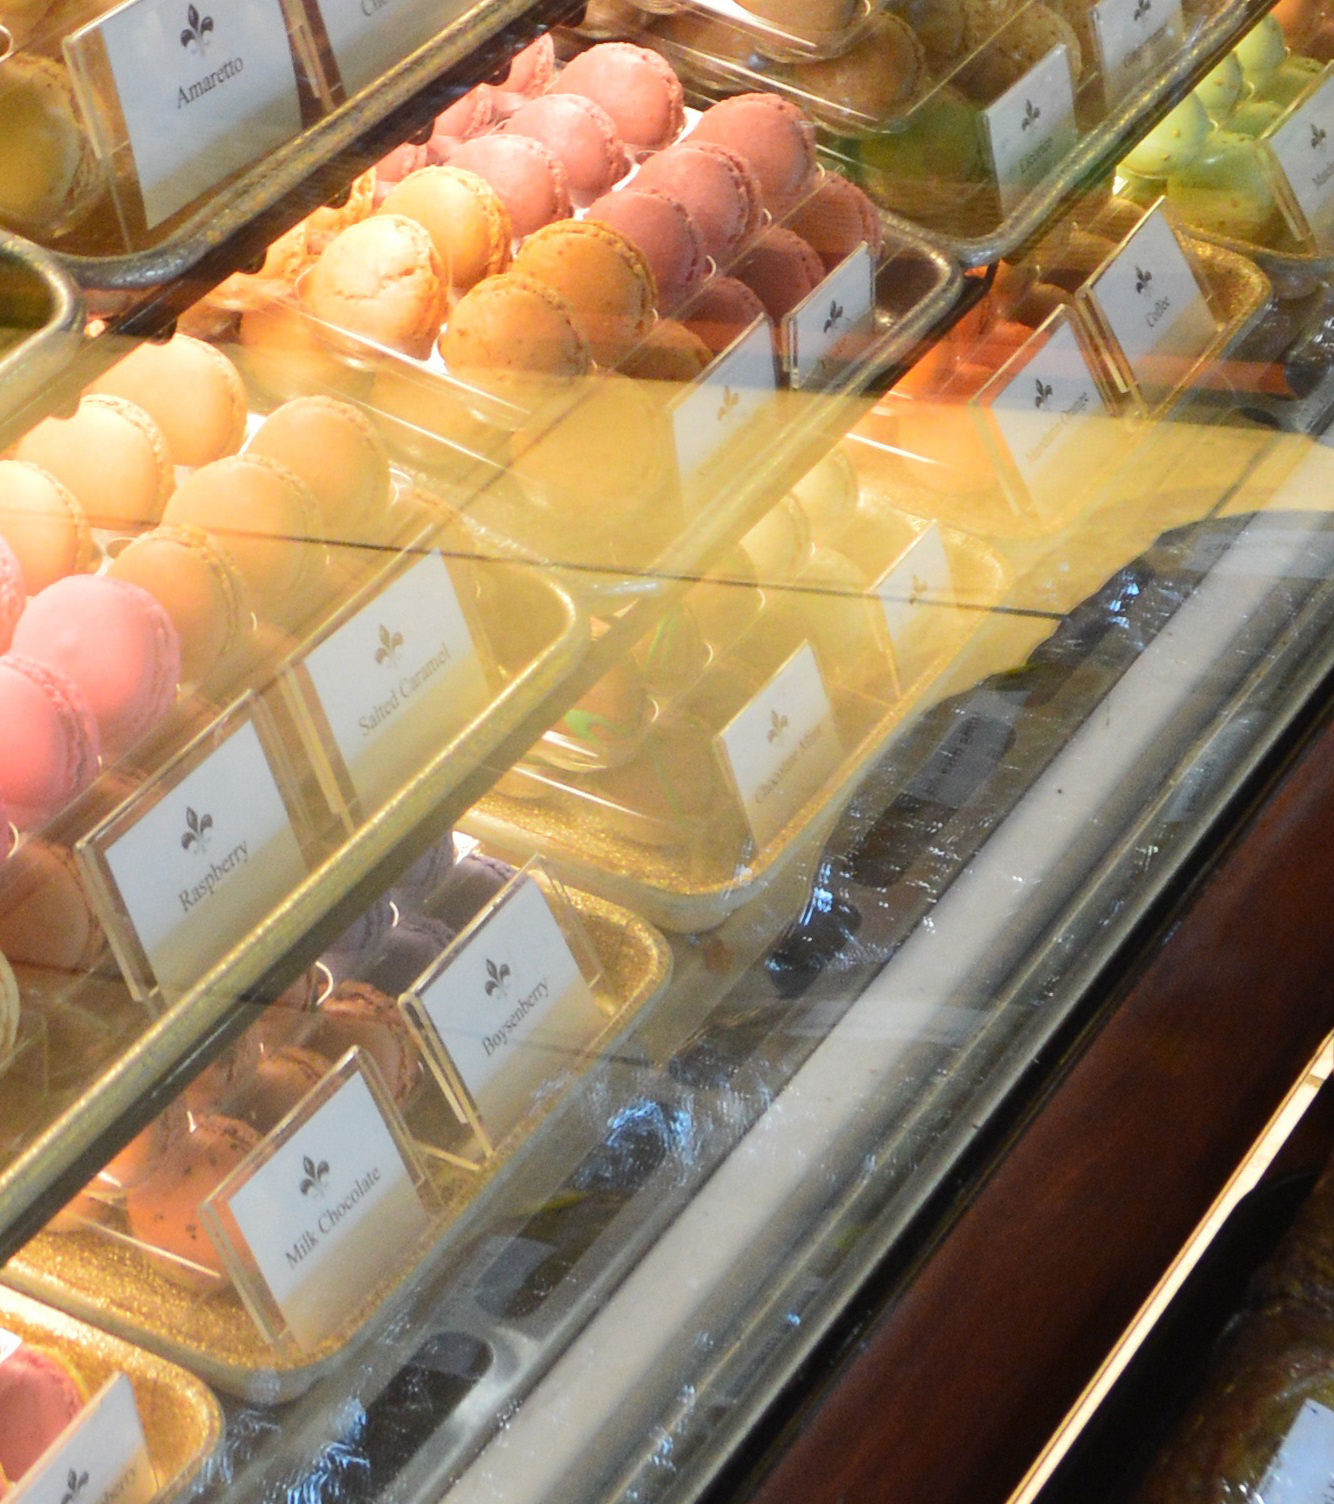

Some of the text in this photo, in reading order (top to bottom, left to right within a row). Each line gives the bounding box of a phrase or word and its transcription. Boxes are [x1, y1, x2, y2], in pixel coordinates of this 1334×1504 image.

[175, 55, 244, 110] Amaretto
[357, 641, 450, 738] Salted Caramel
[177, 838, 251, 913] Raspberry
[480, 977, 552, 1058] Boysenberry
[283, 1164, 382, 1274] Milk Chocolate
